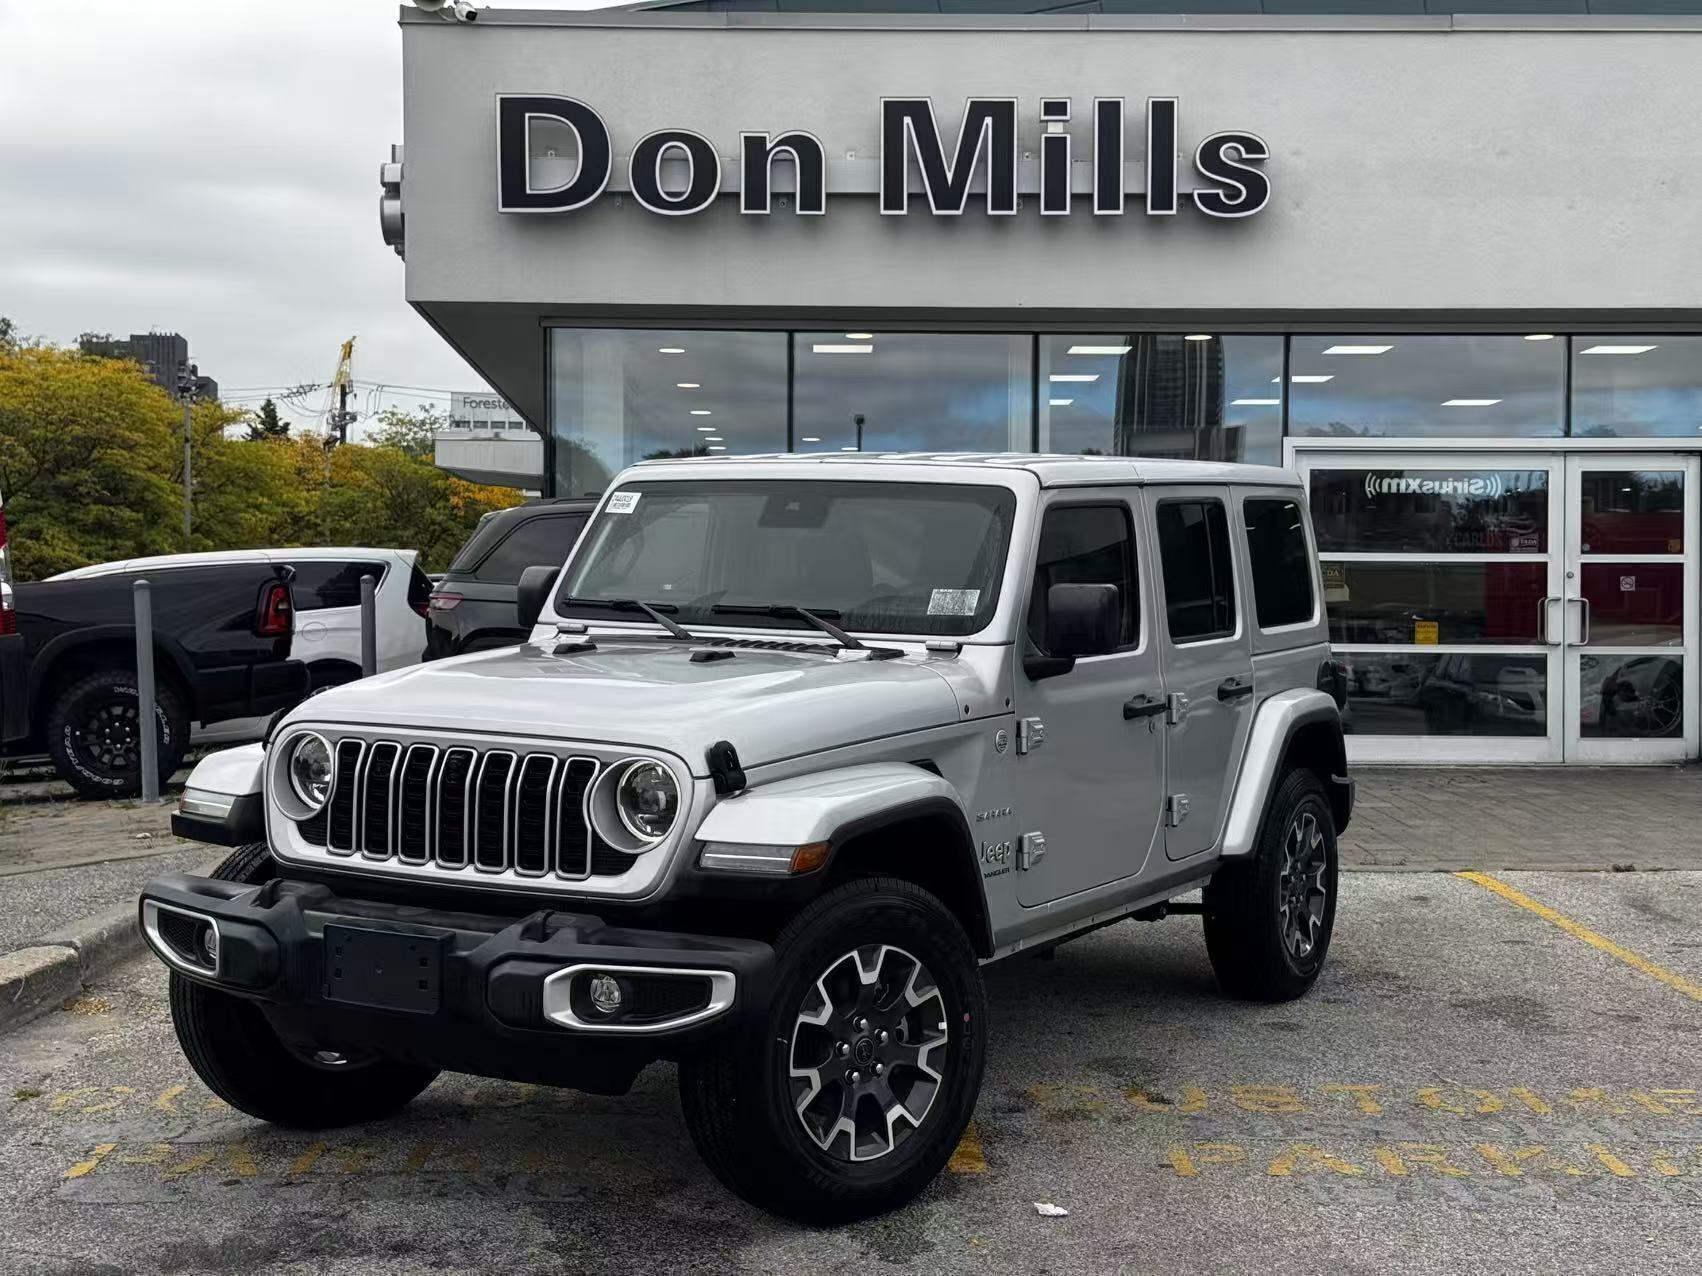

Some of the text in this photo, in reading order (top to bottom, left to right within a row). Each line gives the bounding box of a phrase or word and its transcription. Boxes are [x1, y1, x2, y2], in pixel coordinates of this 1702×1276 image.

[496, 94, 1271, 219] Don Mills
[980, 840, 1011, 865] Jeep
